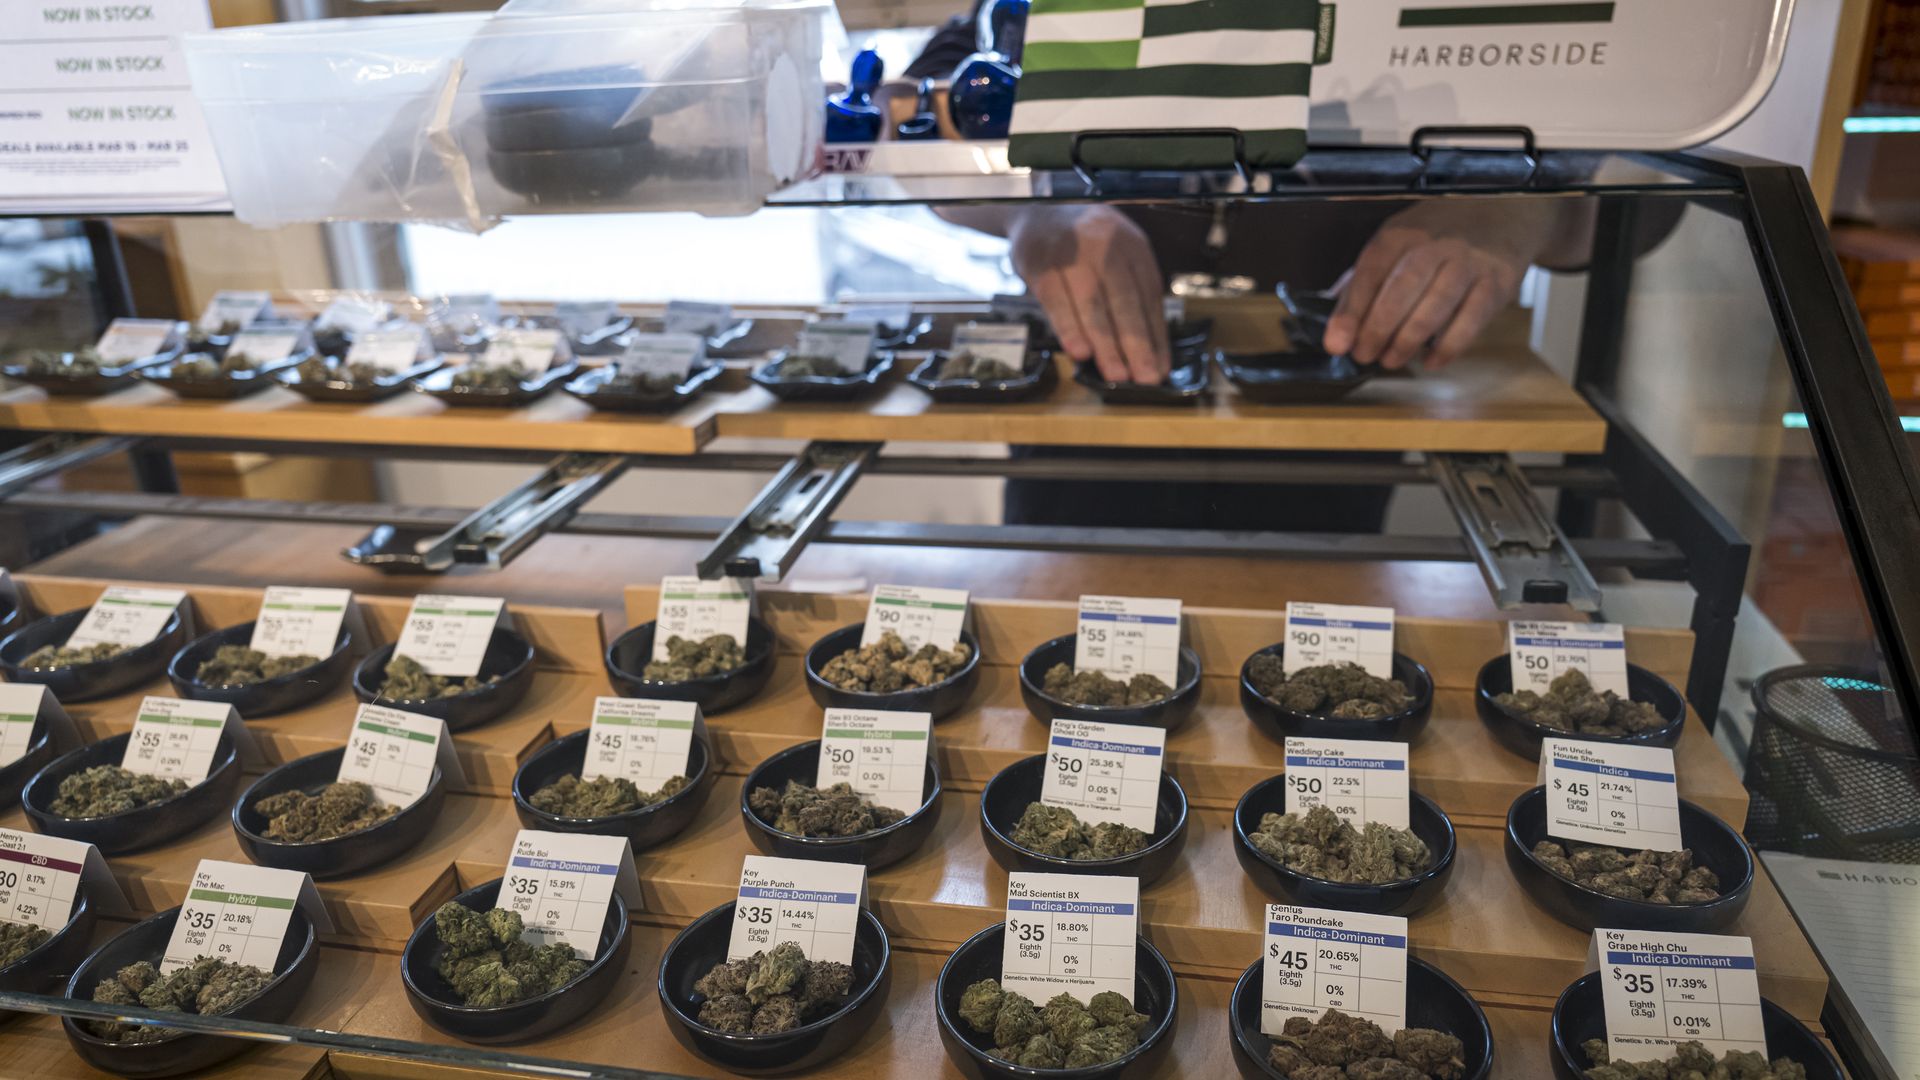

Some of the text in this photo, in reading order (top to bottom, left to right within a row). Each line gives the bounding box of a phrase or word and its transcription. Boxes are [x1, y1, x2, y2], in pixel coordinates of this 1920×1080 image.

[43, 5, 155, 22] NOW IN STOCK
[1389, 41, 1608, 67] HARBORSIDE
[56, 56, 165, 72] NOW IN STOCK
[68, 106, 176, 121] NOW IN STOCK
[875, 608, 900, 623] $90
[1081, 626, 1106, 642] $55
[1292, 631, 1320, 645] $90
[1531, 638, 1603, 648] Indica Dominant
[1517, 651, 1548, 669] $50
[1078, 724, 1105, 732] Garden
[135, 729, 161, 747] $55
[864, 730, 892, 739] Hybrid
[595, 733, 622, 749] $45
[353, 738, 377, 756] $45
[1287, 748, 1322, 756] Wedding
[1570, 746, 1592, 755] Uncle
[825, 745, 854, 763] $50
[1554, 752, 1605, 764] House Shoes
[1051, 753, 1082, 773] $50
[1090, 759, 1113, 768] 25.36
[1306, 758, 1385, 768] Indica Dominant
[1599, 766, 1629, 777] Indica
[1288, 775, 1322, 793] $50
[1333, 777, 1360, 785] 22.5%
[1088, 785, 1108, 793] 0.05
[1600, 783, 1632, 793] 21.74%
[1567, 798, 1588, 806] Eighth
[1567, 805, 1587, 813] (3.5g)
[1611, 811, 1626, 819] 0%
[0, 833, 23, 842] Henry's
[517, 848, 535, 857] Rude
[31, 856, 47, 865] CBD
[198, 872, 211, 880] Key
[744, 869, 759, 877] Key
[27, 874, 45, 885] 8.17%
[549, 880, 575, 889] 15.91%
[743, 878, 795, 888] Purple Punch
[1844, 873, 1920, 886] HARBO
[196, 880, 224, 890] The Mac
[509, 875, 539, 895] $35
[1010, 881, 1025, 890] Key
[759, 889, 838, 902] Indica-Dominant
[1030, 890, 1066, 898] Scientist
[228, 894, 258, 905] Hybrid
[514, 896, 532, 904] Eighth
[17, 904, 38, 915] 4.22%
[1032, 901, 1115, 913] Indica-Dominant
[184, 908, 216, 929] $35
[224, 913, 252, 924] 20.18%
[546, 910, 560, 919] 0%
[738, 906, 772, 924] $35
[782, 910, 814, 920] 14.44%
[1270, 912, 1344, 927] Taro Poundcake
[1010, 918, 1045, 941] $35
[1057, 923, 1089, 932] 18.80%
[187, 930, 206, 938] Eighth
[748, 935, 768, 943] (3.5g)
[1294, 926, 1385, 945] Indica-Dominant
[1606, 932, 1624, 941] Key
[185, 937, 204, 945] (3.5g)
[218, 944, 232, 952] 0%
[1019, 943, 1042, 951] Eighth
[1608, 941, 1687, 952] Grape High Chu
[1020, 951, 1040, 959] (3.5g)
[1063, 956, 1079, 964] 0%
[1270, 942, 1308, 970] $45
[1319, 950, 1359, 962] 20.65%
[1632, 953, 1732, 967] Indica Dominant
[1280, 970, 1303, 979] Eighth
[1280, 978, 1302, 987] (3.5g)
[1613, 967, 1654, 994] $35
[1666, 978, 1707, 989] 17.39%
[1326, 985, 1344, 996] 0%
[1291, 1006, 1318, 1014] Unknown
[1630, 1000, 1656, 1010] Eighth
[1631, 1009, 1656, 1018] (3.5g)
[1673, 1016, 1711, 1028] 0.01%
